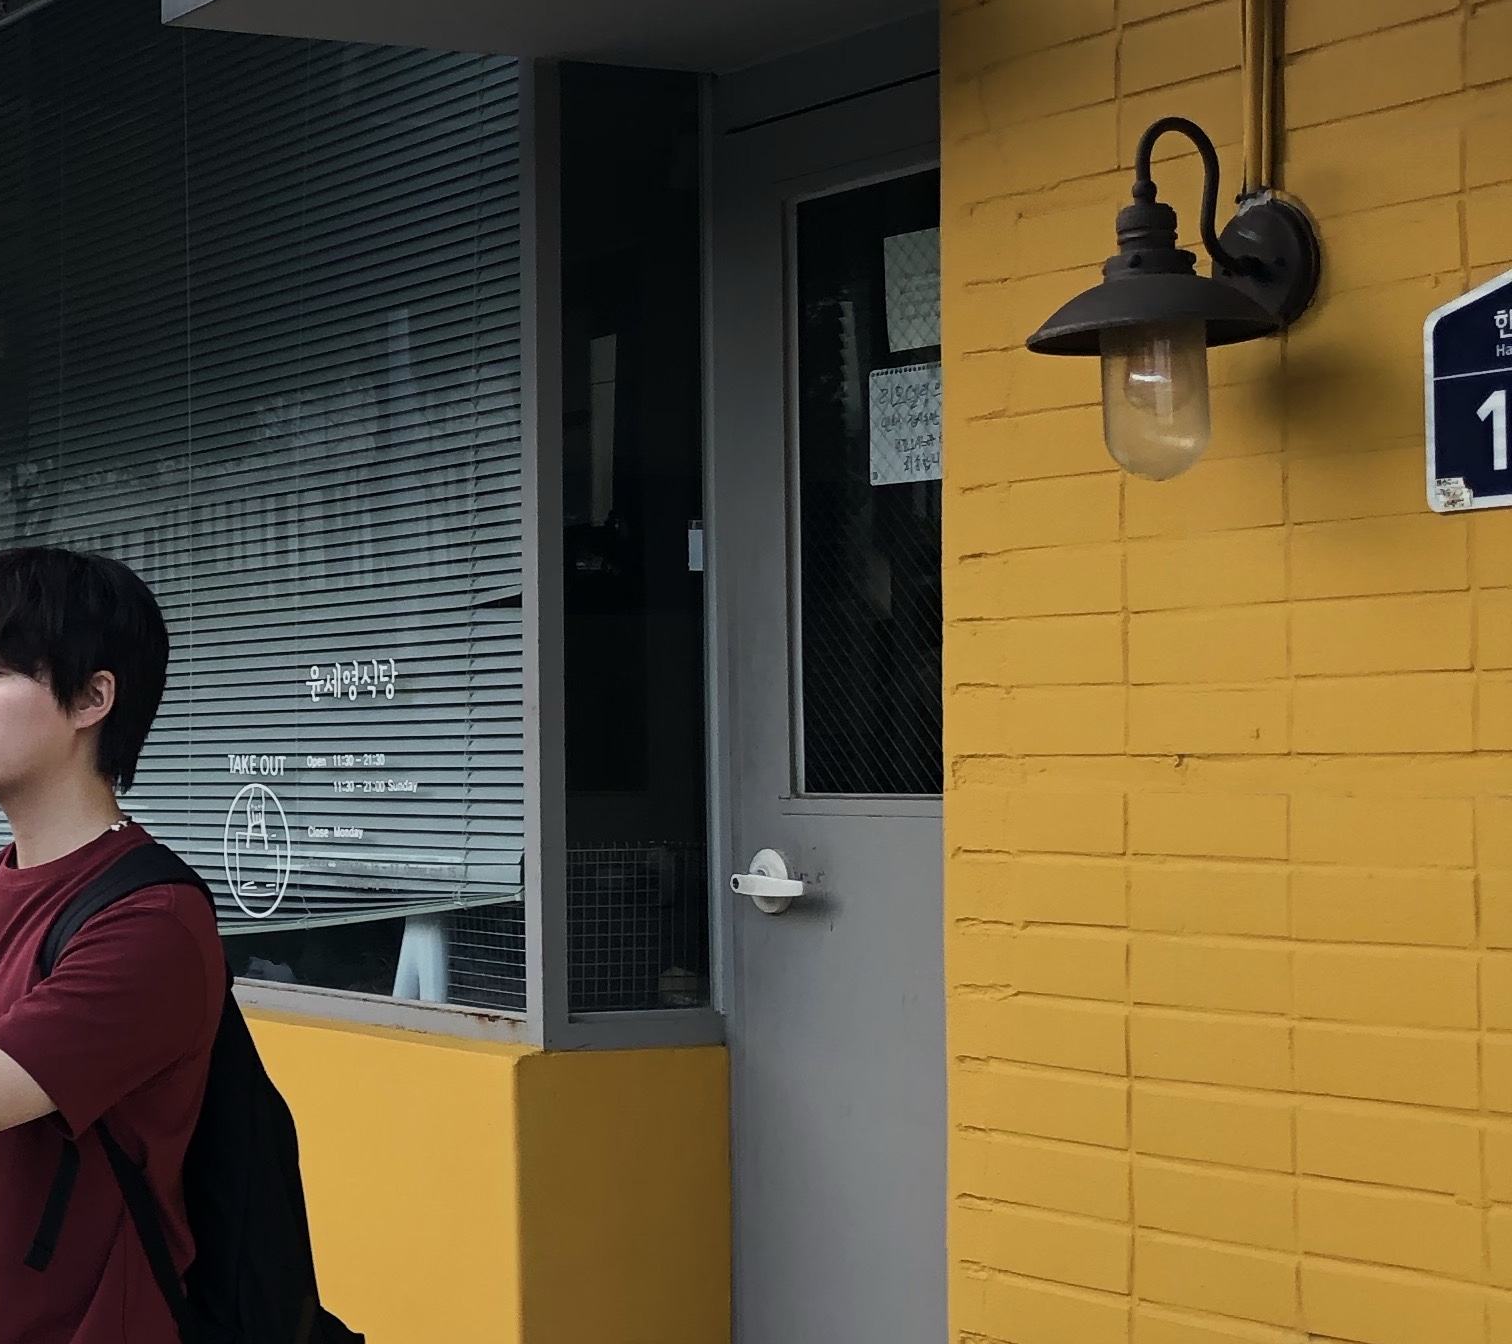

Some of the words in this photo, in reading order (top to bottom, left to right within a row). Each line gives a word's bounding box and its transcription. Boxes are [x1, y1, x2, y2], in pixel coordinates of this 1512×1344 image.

[1476, 389, 1508, 471] 1
[305, 658, 398, 702] 윤세영식당
[228, 754, 257, 775] TAKE
[259, 755, 286, 776] OUT
[306, 755, 327, 768] Open
[387, 779, 418, 793] Sunday
[307, 826, 329, 838] Close
[333, 826, 364, 840] Monday
